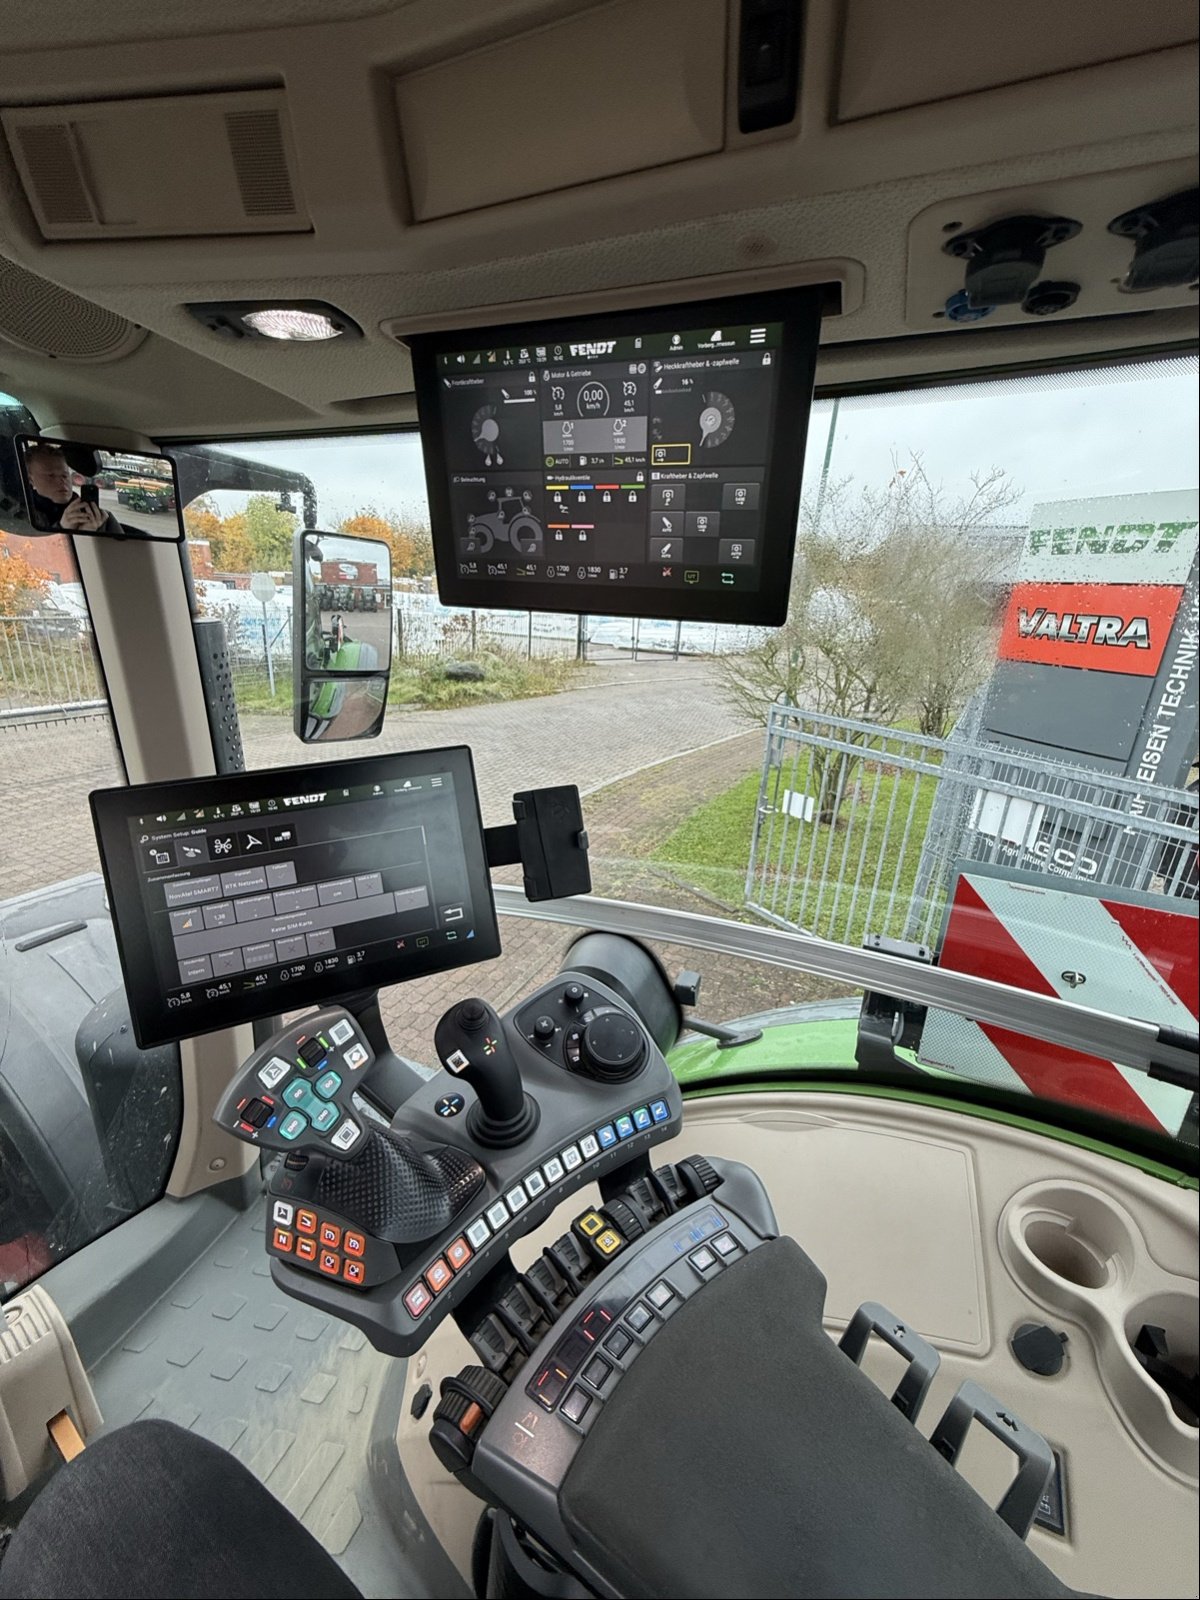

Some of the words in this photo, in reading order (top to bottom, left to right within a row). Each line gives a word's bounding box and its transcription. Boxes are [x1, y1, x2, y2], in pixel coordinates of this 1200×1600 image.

[569, 341, 616, 356] FENDT
[570, 370, 592, 378] Getriebe
[583, 389, 604, 402] 0,00
[586, 402, 600, 410] km/h
[693, 471, 719, 480] Zapfwelle
[1029, 521, 1199, 556] FENDT
[1018, 606, 1151, 650] VALTRA
[1156, 628, 1199, 718] TECHNIK
[283, 792, 327, 807] FENDT
[151, 834, 172, 842] System
[191, 828, 207, 836] Guide
[238, 878, 264, 888] Netzwerk
[193, 886, 219, 896] SMART7
[271, 925, 286, 933] Keine
[286, 922, 298, 930] SIM
[324, 956, 339, 965] 1830
[290, 964, 306, 973] 1700
[255, 973, 268, 982] 45,1
[219, 982, 232, 990] 45,1
[325, 1079, 333, 1088] GO
[294, 1088, 303, 1098] GO
[318, 1109, 328, 1121] END
[287, 1120, 298, 1132] END
[279, 1234, 287, 1244] N
